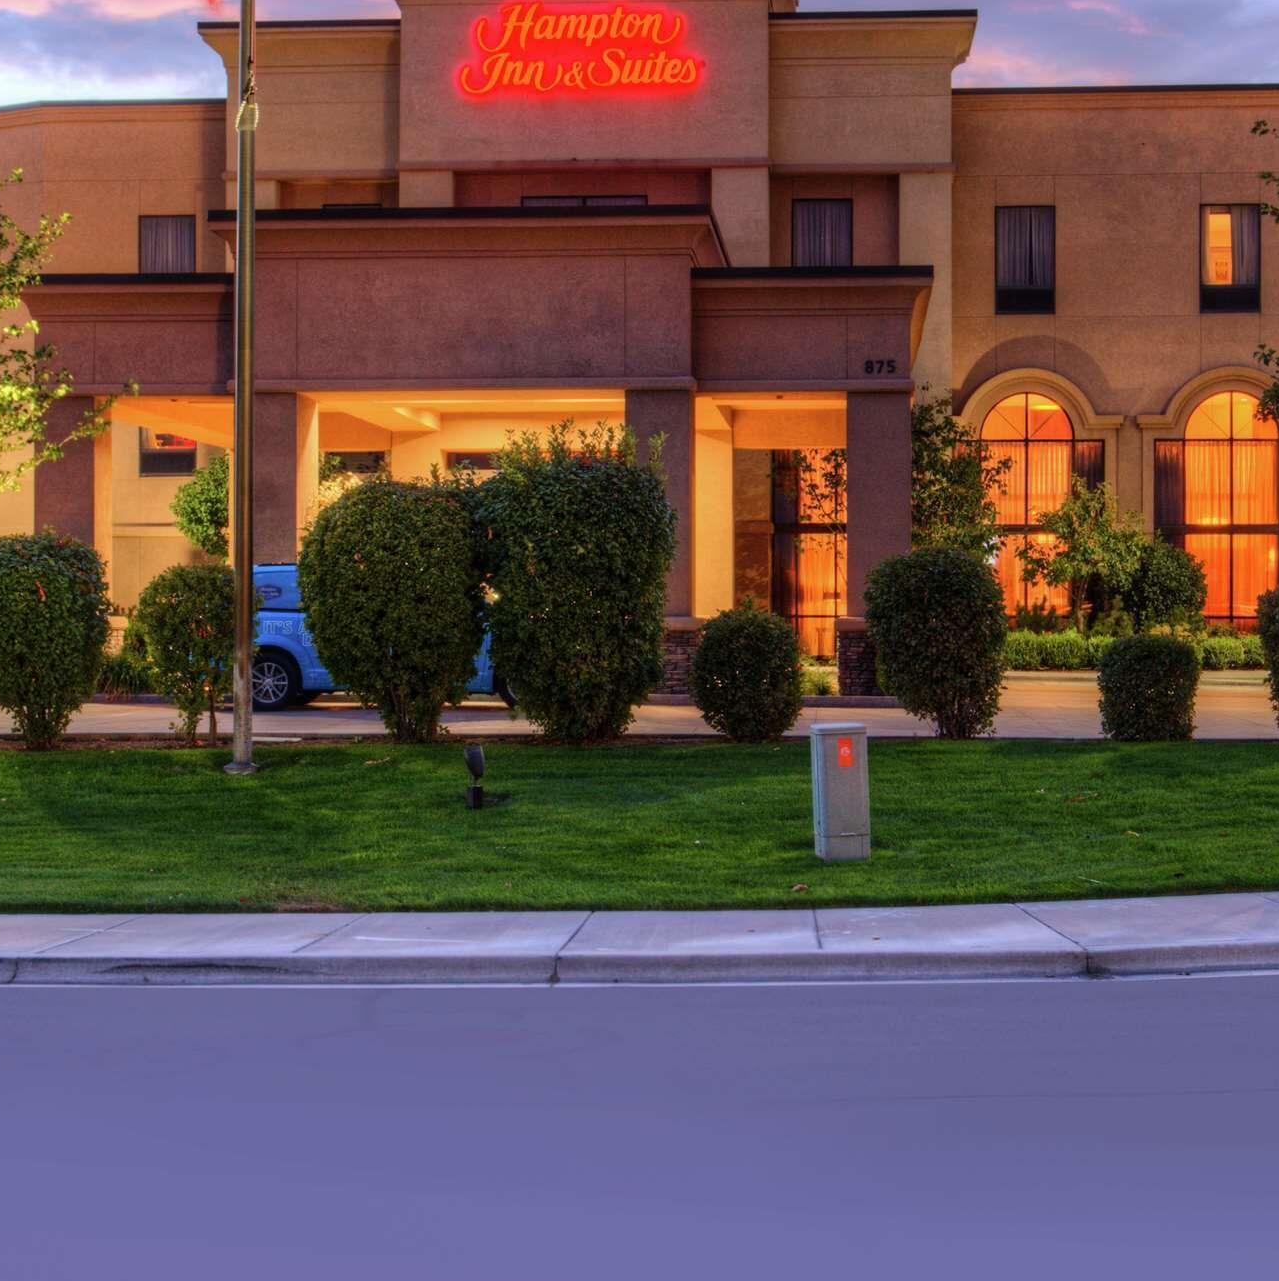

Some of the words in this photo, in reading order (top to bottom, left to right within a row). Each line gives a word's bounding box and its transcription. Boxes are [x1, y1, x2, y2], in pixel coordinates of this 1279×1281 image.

[477, 2, 680, 52] Hampton
[460, 52, 562, 94] Inn
[564, 62, 587, 90] &
[588, 48, 697, 87] Suites
[865, 360, 896, 374] 875
